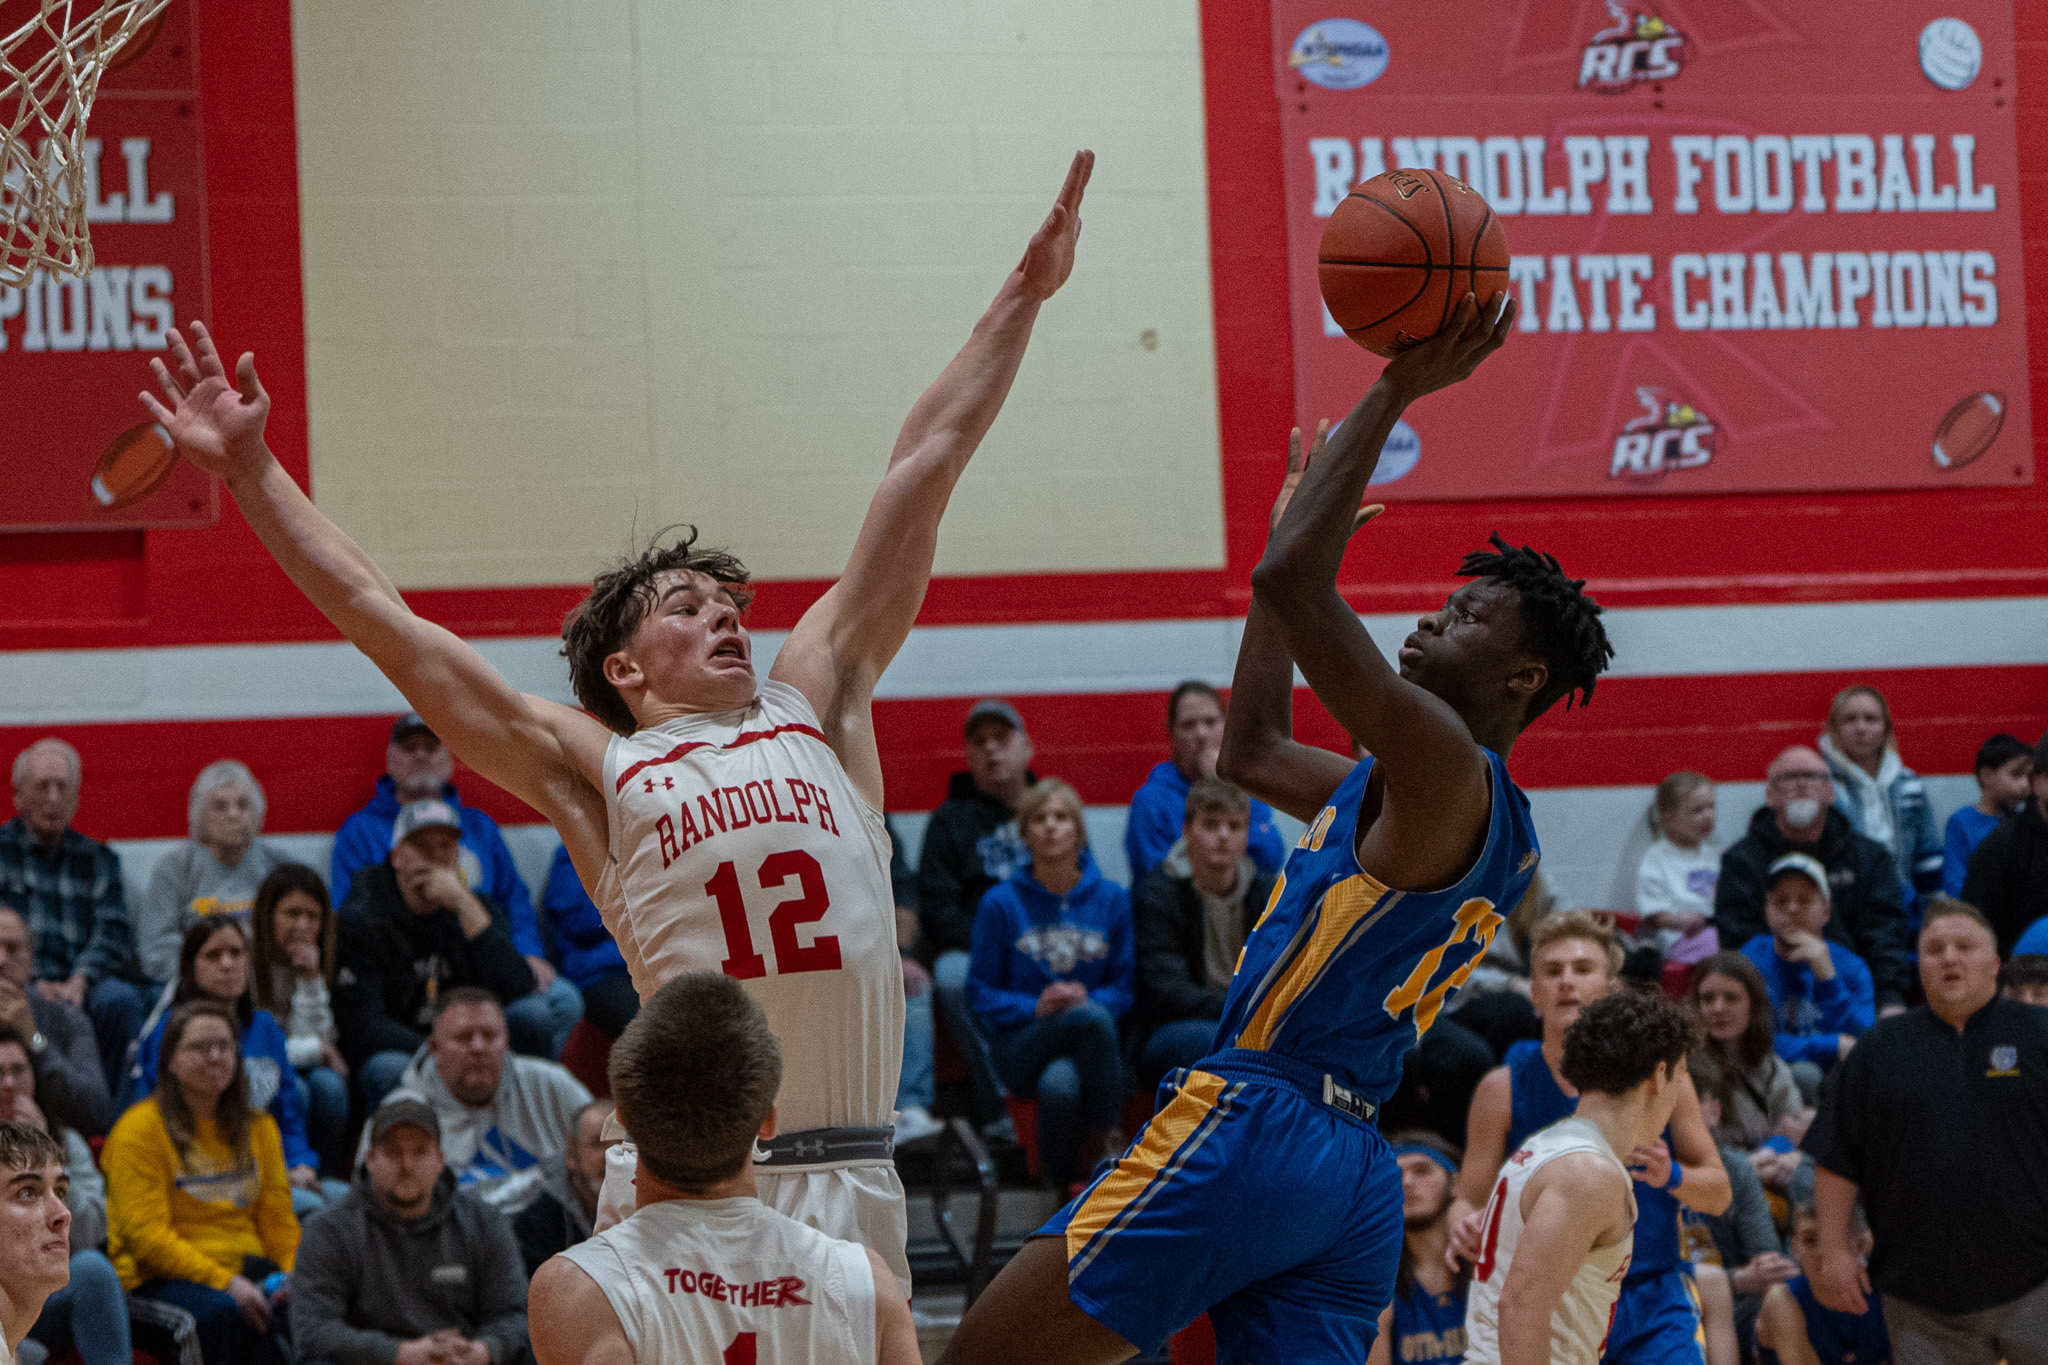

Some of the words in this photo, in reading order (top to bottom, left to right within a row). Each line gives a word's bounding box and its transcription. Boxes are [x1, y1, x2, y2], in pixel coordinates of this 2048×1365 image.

[1578, 37, 1683, 87] RCS
[1671, 134, 1998, 213] FOOTBALL
[1496, 254, 1656, 334] TATE
[1671, 251, 1999, 331] CHAMPIONS
[1609, 423, 1714, 478] RCS
[654, 777, 841, 871] RANDOLPH
[704, 849, 843, 981] 12
[663, 1268, 814, 1308] TOGETHER
